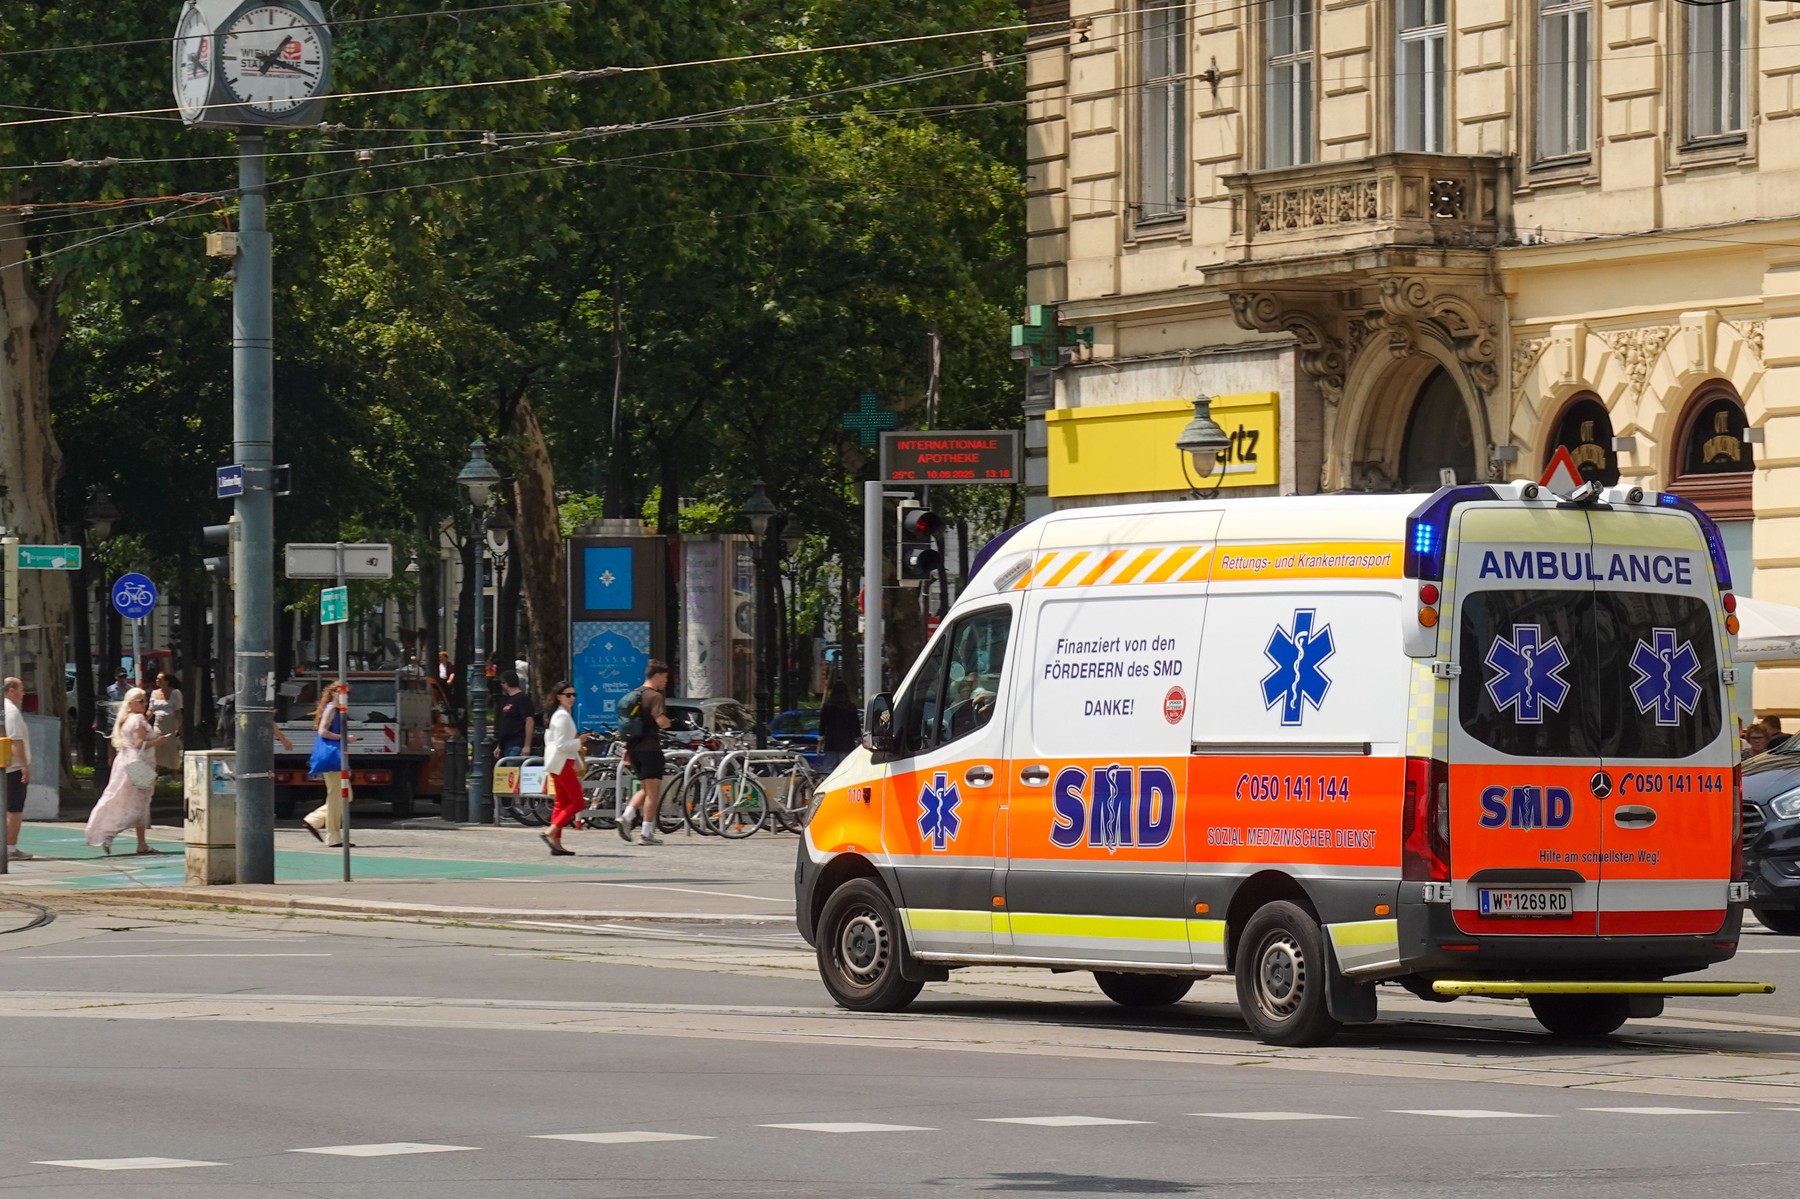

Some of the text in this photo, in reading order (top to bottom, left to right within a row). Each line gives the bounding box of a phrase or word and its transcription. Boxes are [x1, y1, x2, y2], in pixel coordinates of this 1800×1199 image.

[897, 439, 998, 450] INTERNATIONALE
[917, 453, 980, 464] APOTHEKE
[892, 471, 915, 480] 25°C
[985, 469, 1010, 478] 13:18
[1221, 552, 1392, 571] Rettungs- und Krankentransport
[1479, 550, 1693, 585] AMBULANCE
[1056, 634, 1176, 655] Finanziert von den
[1043, 659, 1183, 680] FÖRDERERN des SMD
[1084, 698, 1135, 717] DANKE!
[1250, 774, 1350, 803] 050 141 144
[1635, 774, 1723, 794] 050 141 144
[1049, 765, 1178, 851] SMD
[1478, 784, 1574, 831] SMD
[1207, 827, 1377, 849] SOZIAL MEDIZINISCHER DIENST
[1538, 849, 1661, 866] Hilfe am schnellsten Weg!
[1549, 893, 1567, 910] RD
